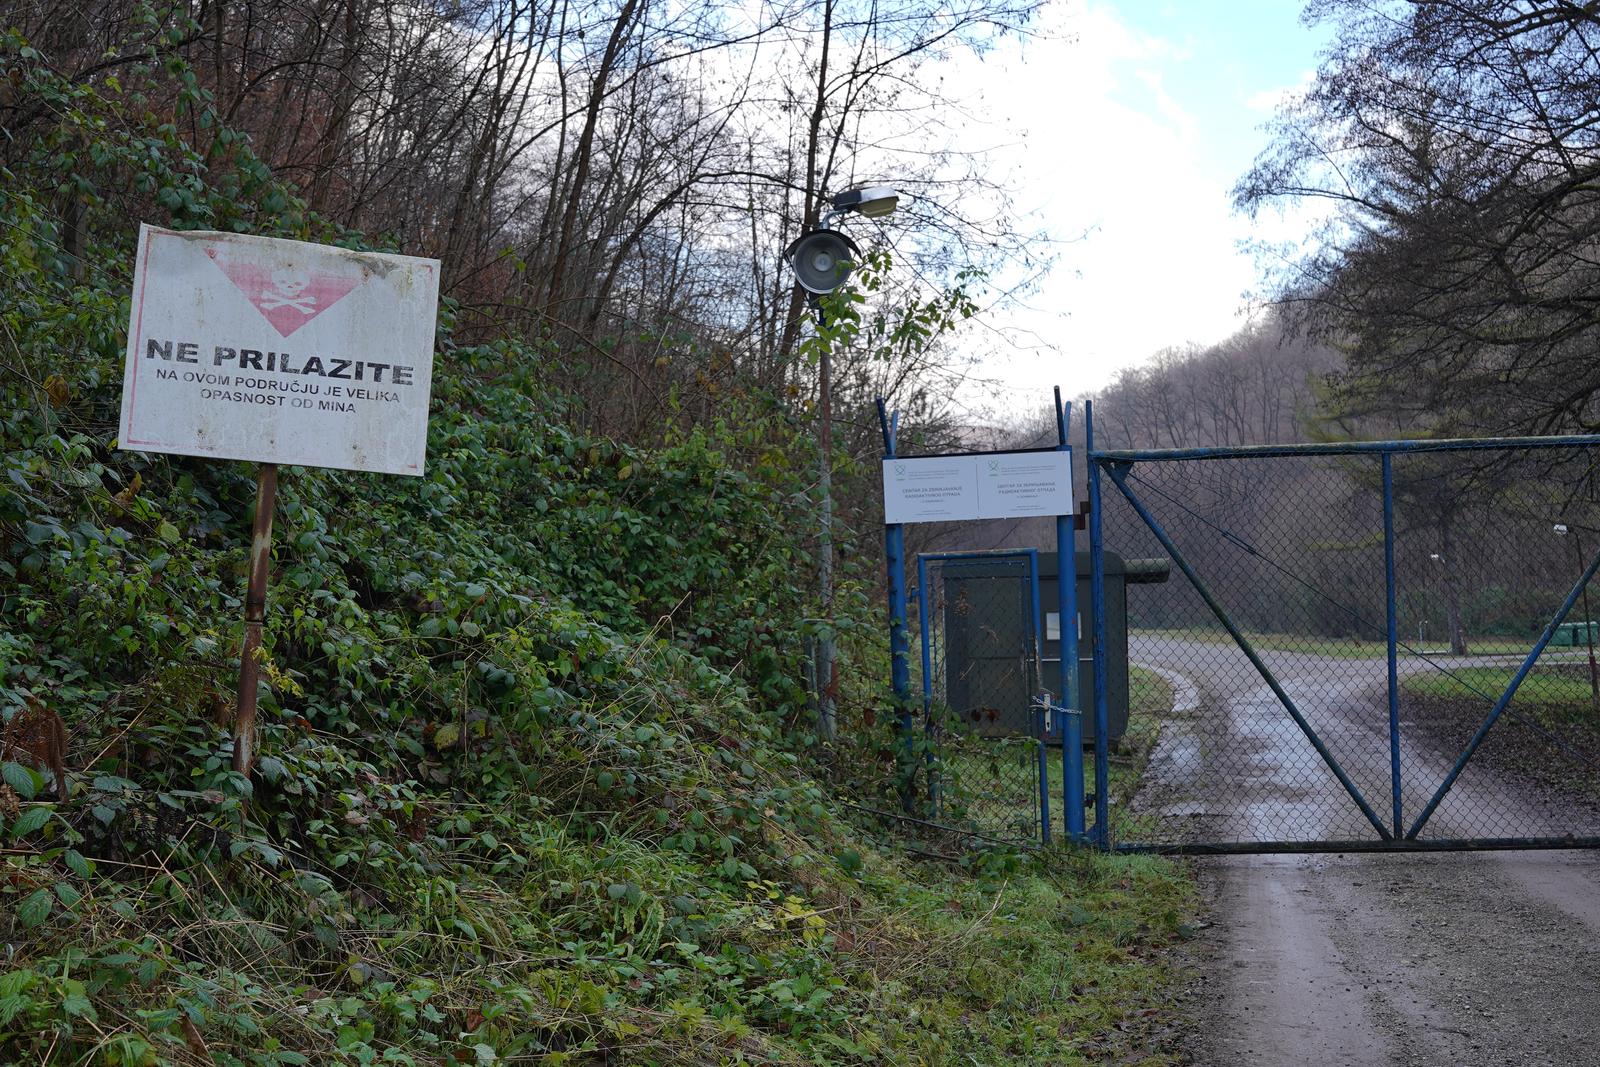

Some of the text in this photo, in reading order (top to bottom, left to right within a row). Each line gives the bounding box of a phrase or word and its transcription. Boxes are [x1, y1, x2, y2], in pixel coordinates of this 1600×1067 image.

[146, 338, 414, 386] NE PRILAZITE
[156, 368, 400, 403] NA OVOM PODRUČJU JE VELIKA
[201, 387, 356, 414] OPASNOST OD MINA
